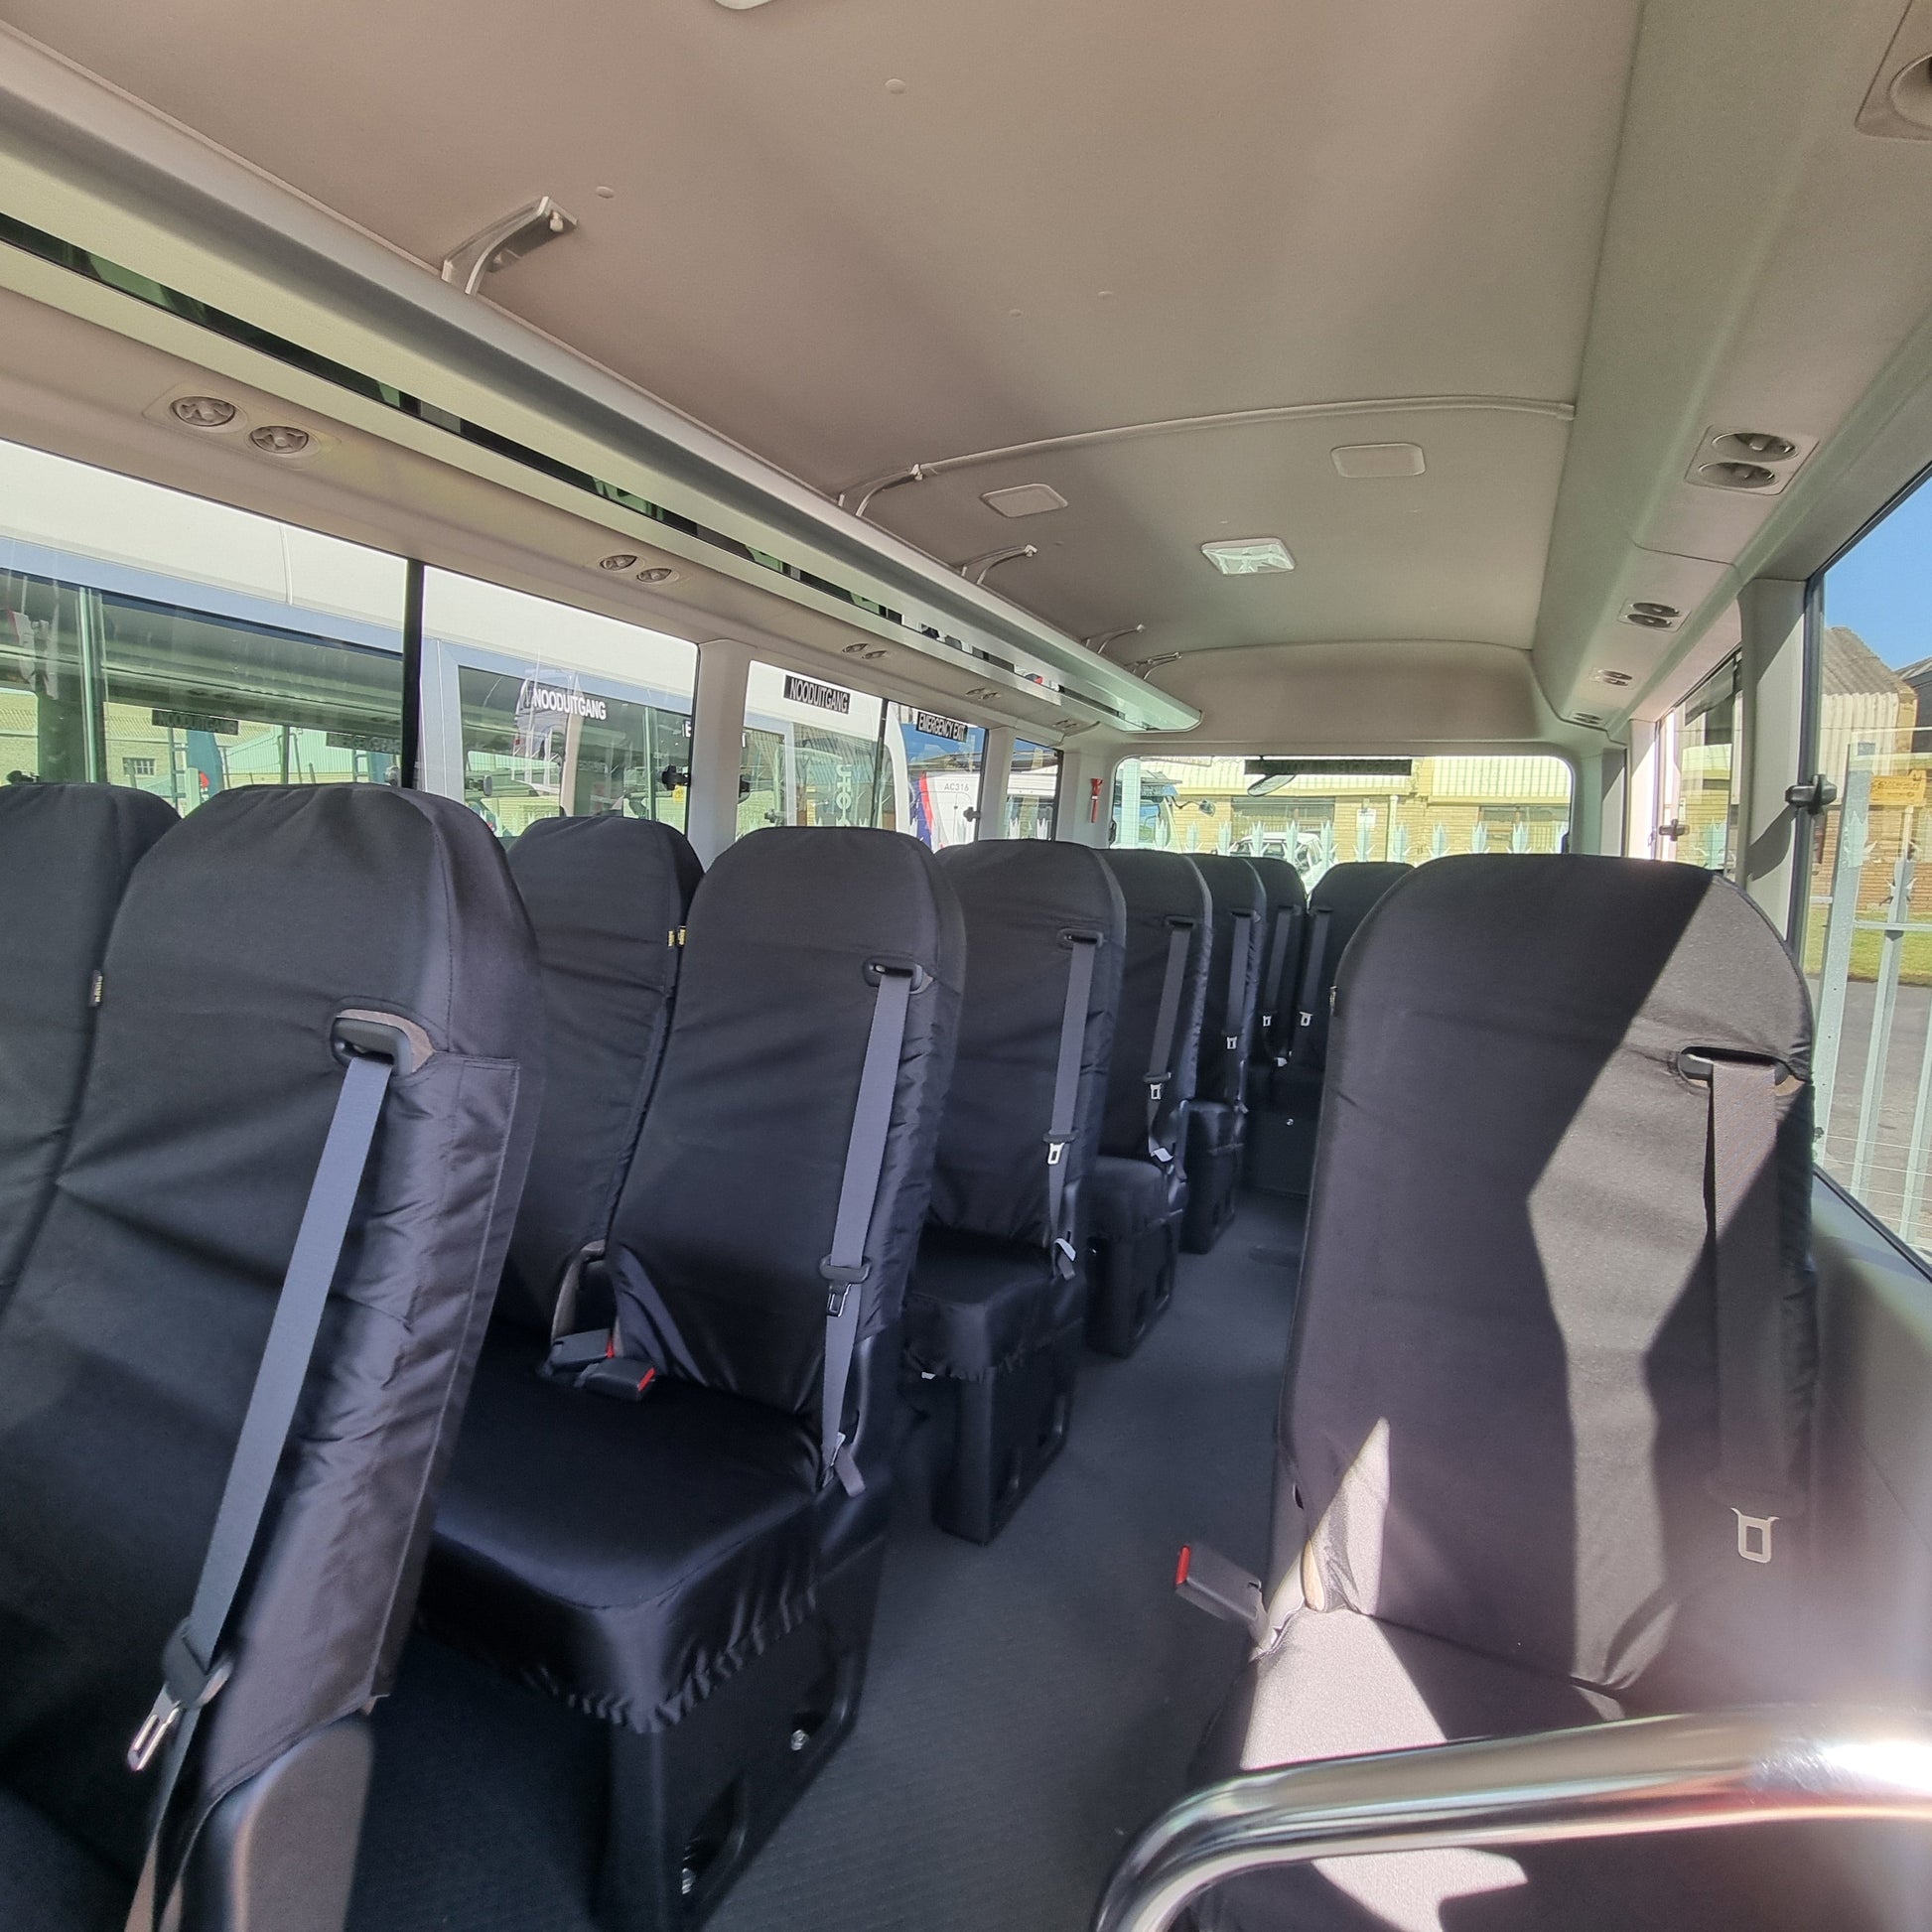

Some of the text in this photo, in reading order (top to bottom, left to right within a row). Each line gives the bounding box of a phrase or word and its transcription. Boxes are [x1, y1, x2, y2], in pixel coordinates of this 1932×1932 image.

[533, 687, 607, 720] NOODUITGANG
[790, 678, 848, 712] NOODUITGANG
[918, 714, 965, 741] EMERGENCY EXIT
[944, 782, 969, 792] AC316
